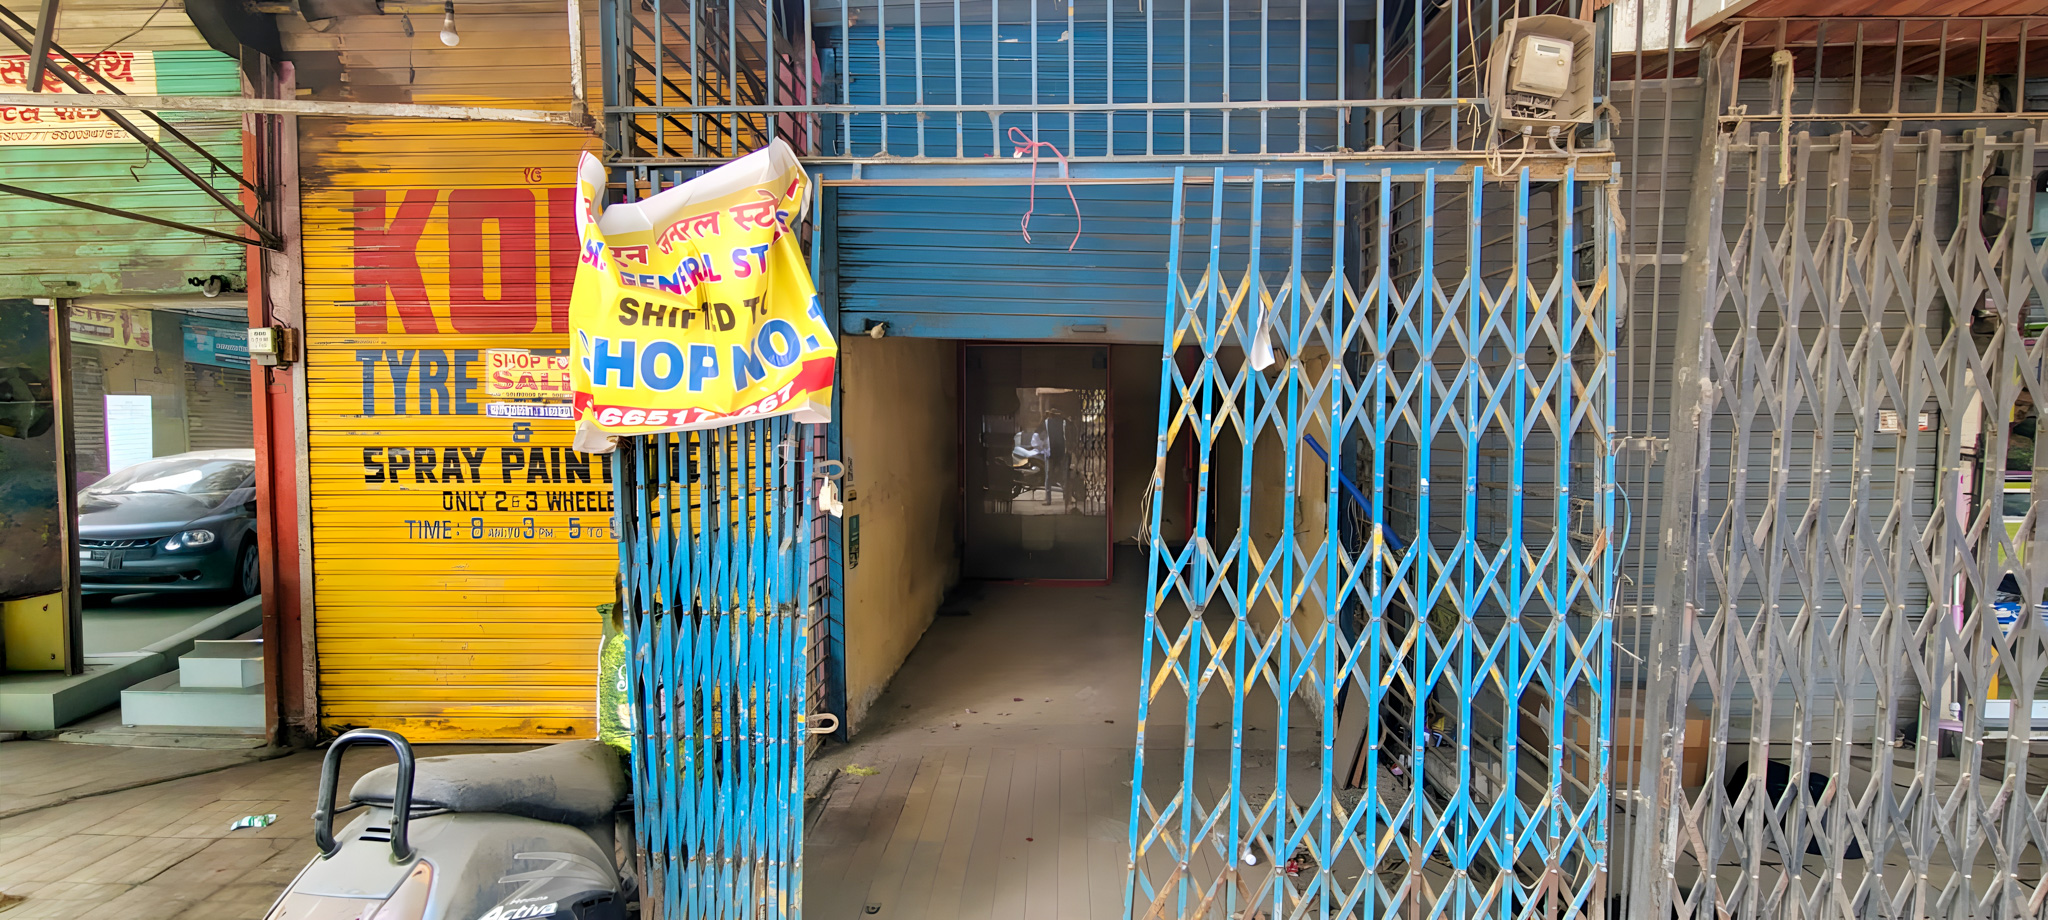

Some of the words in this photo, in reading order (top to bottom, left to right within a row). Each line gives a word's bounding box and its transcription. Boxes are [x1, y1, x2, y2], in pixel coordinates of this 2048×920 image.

[493, 353, 540, 369] SHOP
[356, 349, 478, 415] TYRE
[513, 422, 533, 443] &
[363, 447, 487, 483] SPRAY
[443, 491, 486, 511] ONLY
[495, 491, 508, 511] 2
[526, 491, 537, 511] 3
[471, 517, 483, 539] 8
[523, 517, 534, 539] 3
[569, 517, 581, 539] 5
[477, 901, 558, 920] Activa
